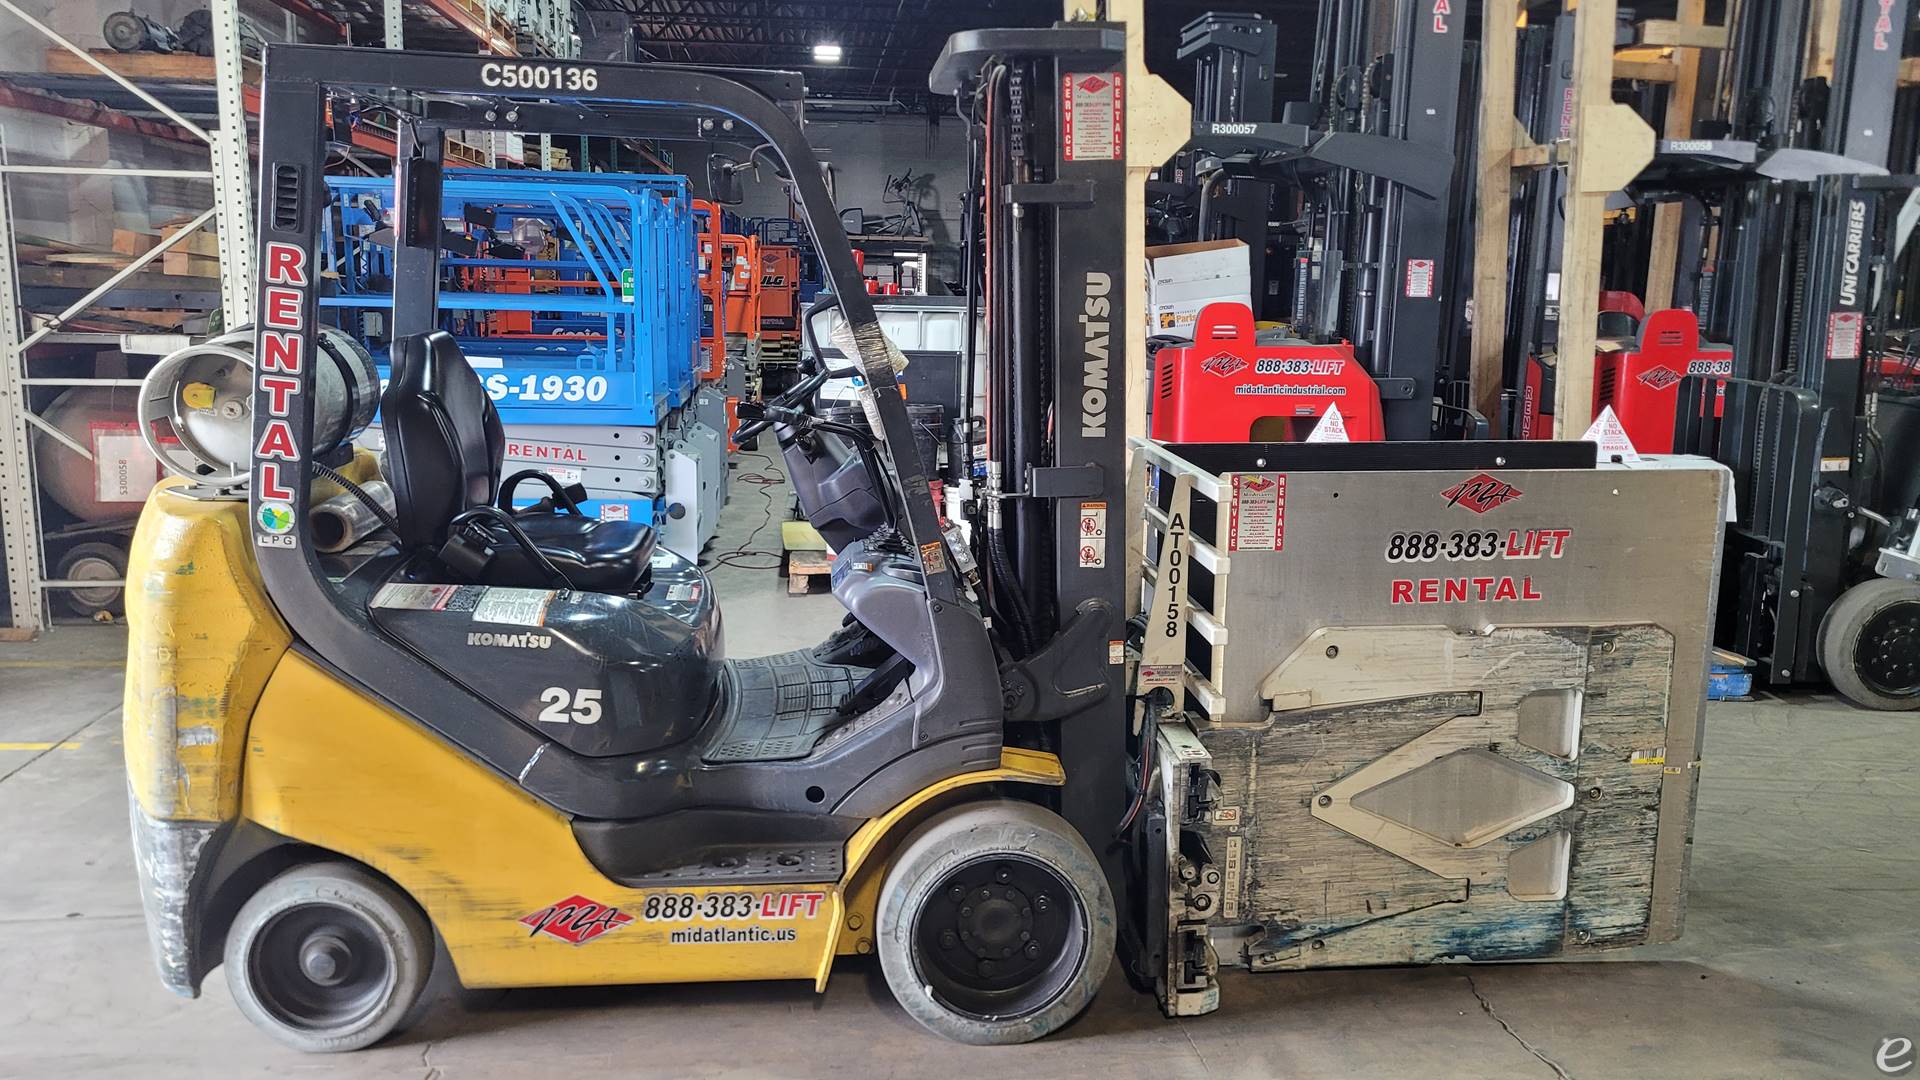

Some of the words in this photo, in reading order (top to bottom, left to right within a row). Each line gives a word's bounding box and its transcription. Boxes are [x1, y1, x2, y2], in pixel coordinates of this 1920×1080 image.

[481, 63, 598, 91] C500136
[1211, 123, 1258, 134] R300057
[1840, 199, 1866, 306] UNICARRIERS
[1079, 272, 1112, 438] KOMATSU
[256, 240, 308, 502] RENTAL
[478, 374, 608, 401] S-1930
[1235, 385, 1346, 395] midatlanticindustrial.com
[508, 444, 588, 461] RENTAL
[1231, 477, 1239, 547] SERVICE
[1276, 477, 1285, 547] RENTALS
[261, 535, 293, 546] LPG
[1165, 512, 1185, 638] AT00158
[1391, 576, 1542, 604] RENTAL
[467, 632, 552, 650] KOMATSU
[538, 686, 603, 725] 25
[671, 927, 797, 942] midatlantic.us
